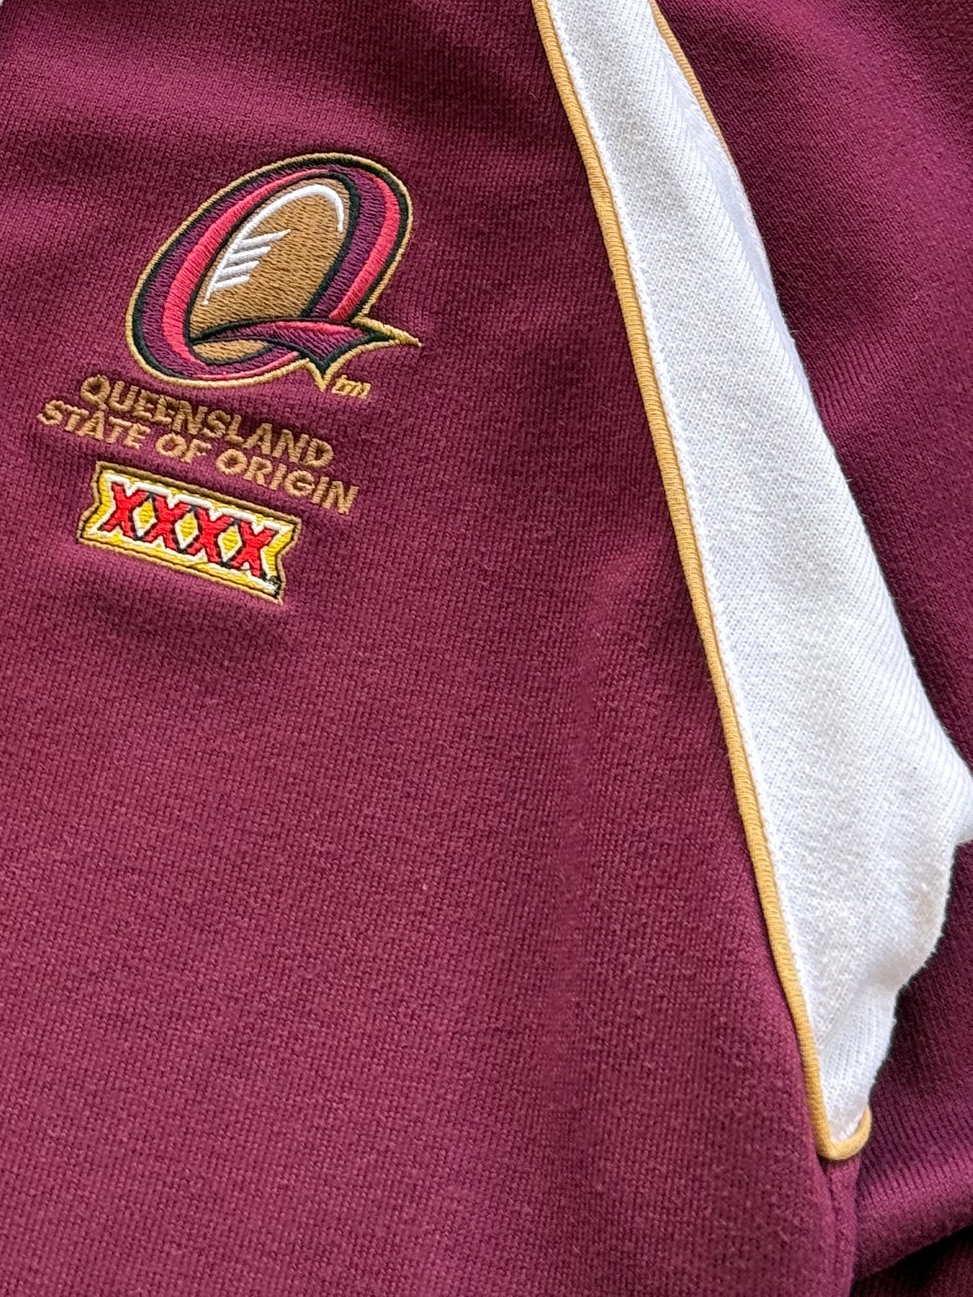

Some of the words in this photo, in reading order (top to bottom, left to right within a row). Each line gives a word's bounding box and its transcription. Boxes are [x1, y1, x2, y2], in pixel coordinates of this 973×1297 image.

[37, 399, 150, 450] STATE
[155, 433, 212, 463] OF
[215, 448, 360, 516] ORIGIN
[79, 373, 334, 469] QUEENSLAND
[98, 480, 279, 579] XXXX
